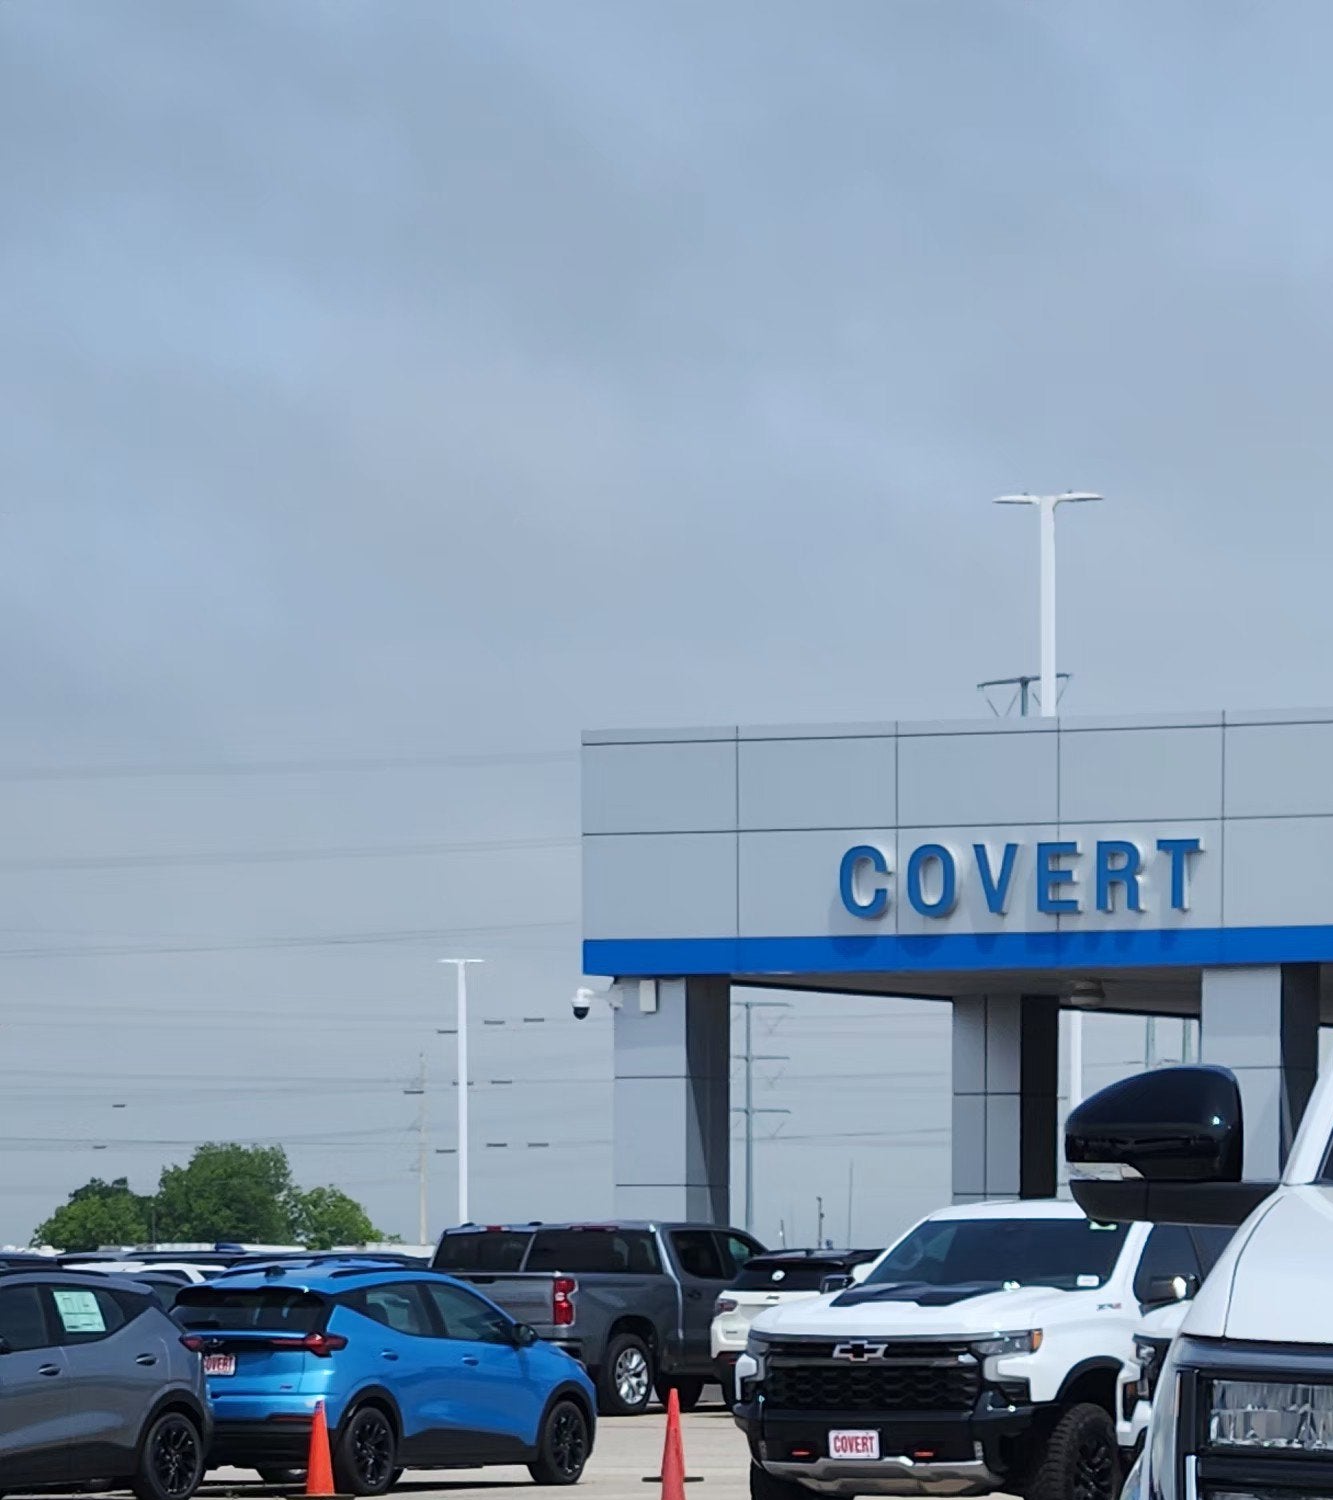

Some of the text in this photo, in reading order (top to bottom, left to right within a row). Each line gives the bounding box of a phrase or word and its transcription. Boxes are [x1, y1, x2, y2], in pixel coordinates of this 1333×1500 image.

[839, 838, 1204, 919] COVERT
[205, 1356, 233, 1371] OVERT
[833, 1435, 874, 1453] COVERT
